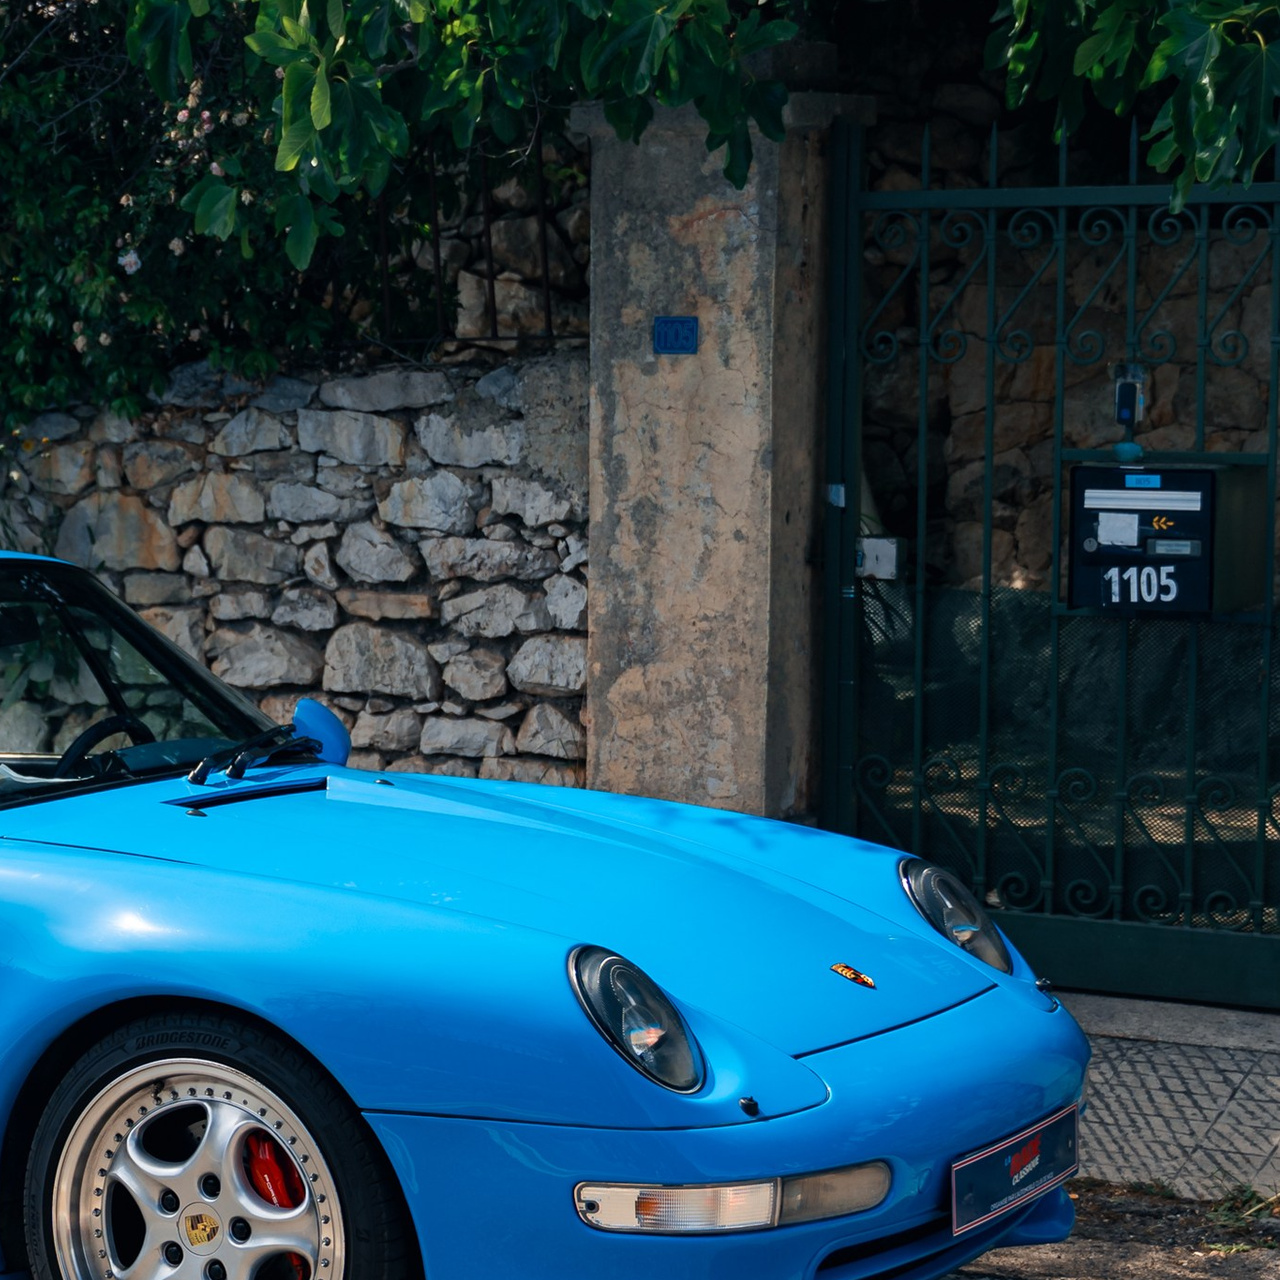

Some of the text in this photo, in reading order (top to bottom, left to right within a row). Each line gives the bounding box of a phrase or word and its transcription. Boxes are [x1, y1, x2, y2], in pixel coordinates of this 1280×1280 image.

[658, 323, 693, 348] 1105
[1103, 565, 1178, 604] 1105
[135, 1031, 231, 1051] BRIDGESTONE
